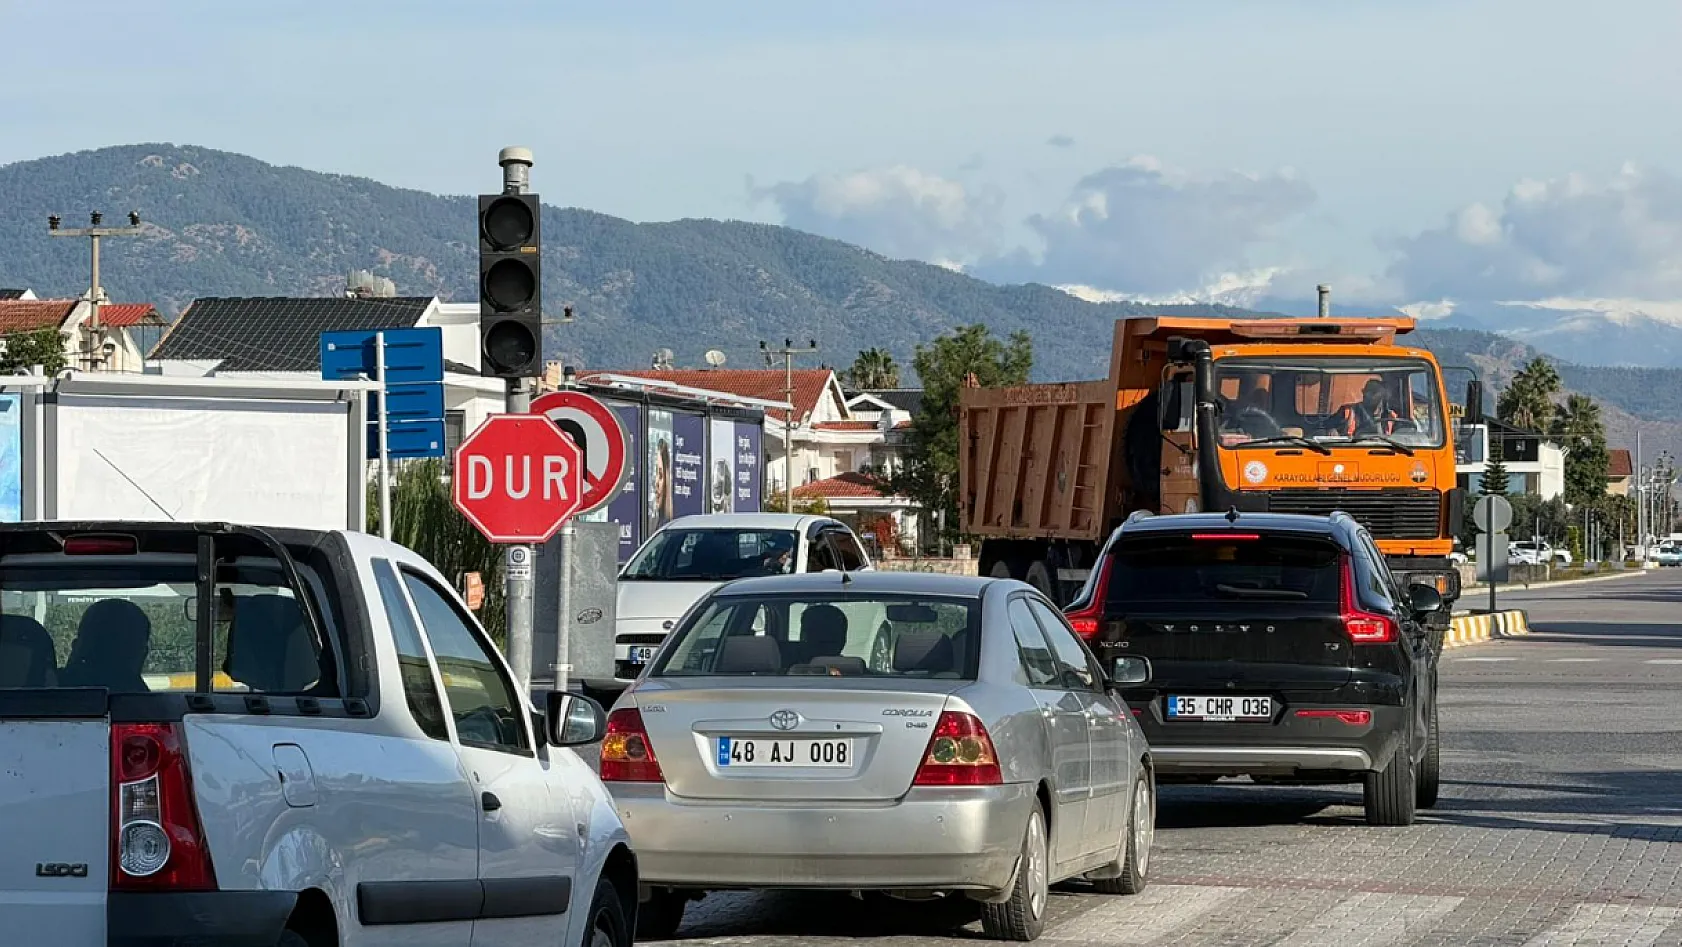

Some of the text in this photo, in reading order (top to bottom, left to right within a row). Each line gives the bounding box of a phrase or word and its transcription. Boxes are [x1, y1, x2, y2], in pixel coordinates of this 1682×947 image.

[467, 455, 569, 500] DUR
[1163, 624, 1276, 632] VOLVO
[1098, 640, 1130, 649] XC40
[638, 648, 652, 659] 48
[1177, 698, 1269, 715] 35 CHR 036
[882, 709, 933, 717] COROLLA
[731, 741, 848, 762] 48 AJ 008
